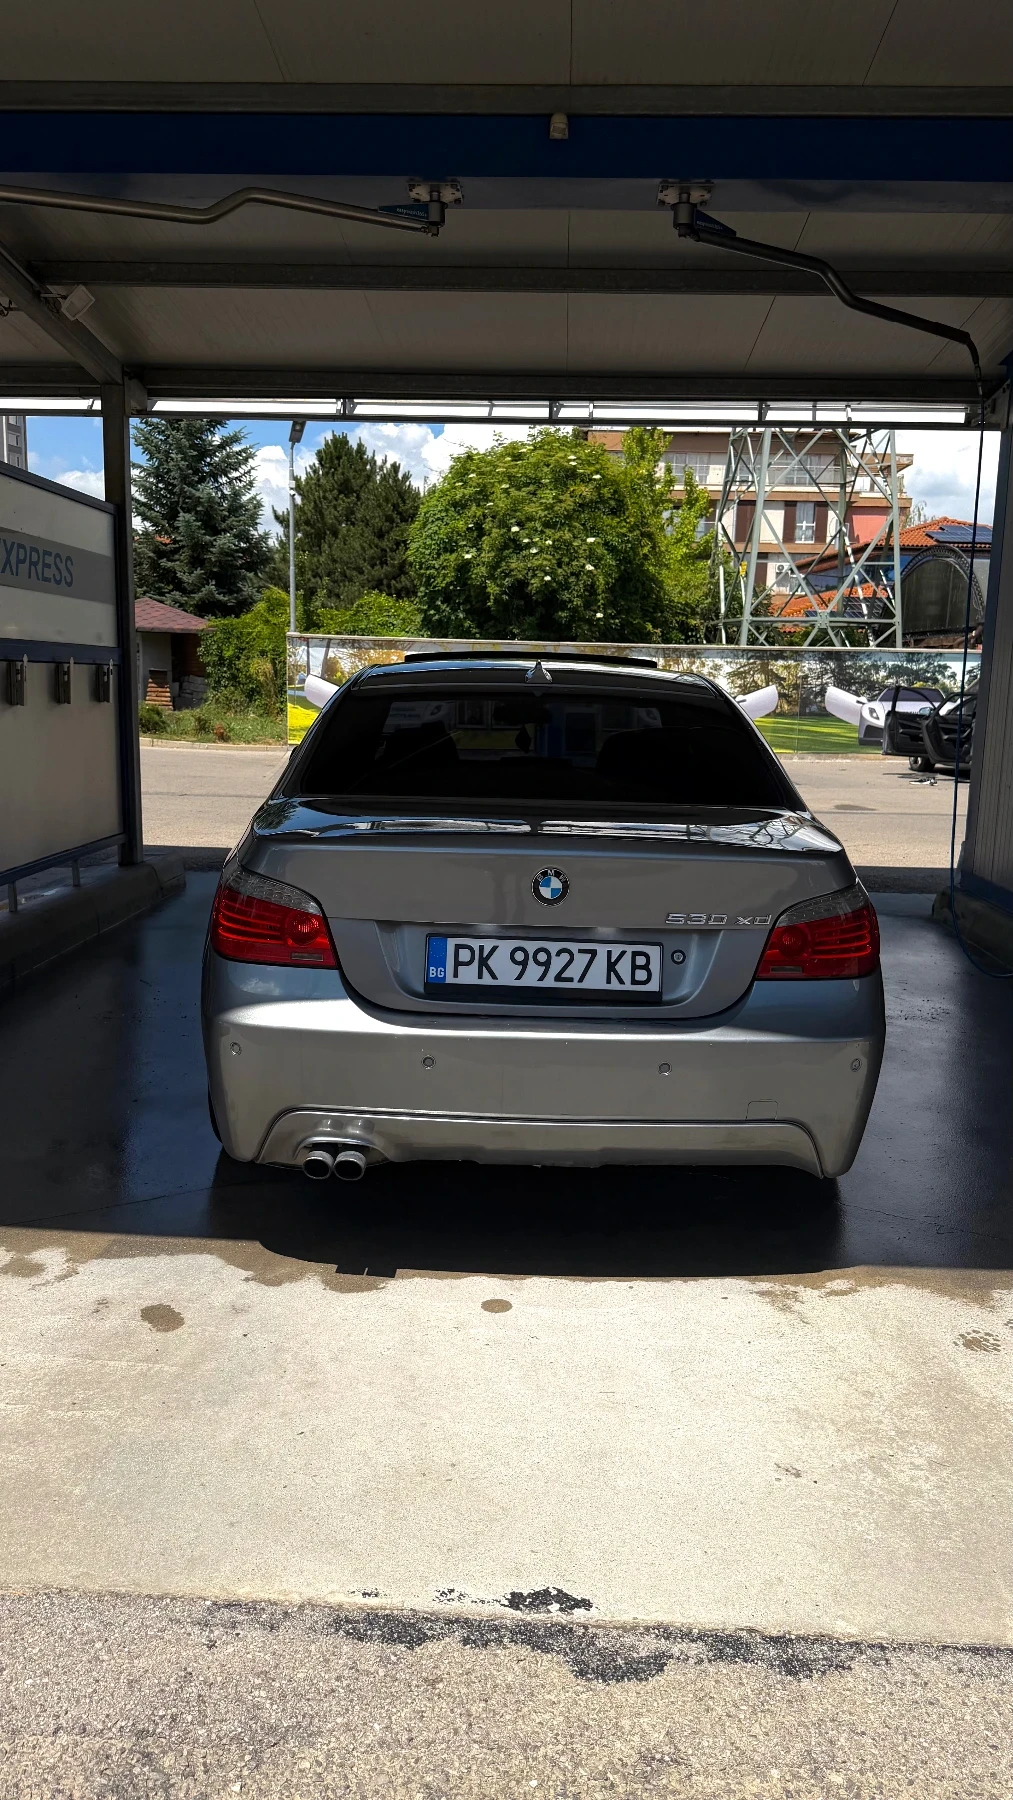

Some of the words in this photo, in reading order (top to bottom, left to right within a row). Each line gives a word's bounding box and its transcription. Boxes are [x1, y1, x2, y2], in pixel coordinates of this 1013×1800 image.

[0, 538, 74, 587] XPRESS
[536, 869, 567, 882] BMW
[665, 913, 728, 925] 530
[735, 914, 772, 925] xd
[452, 943, 499, 981] PK
[509, 946, 598, 984] 9927
[605, 949, 653, 986] KB
[429, 966, 445, 978] BG
